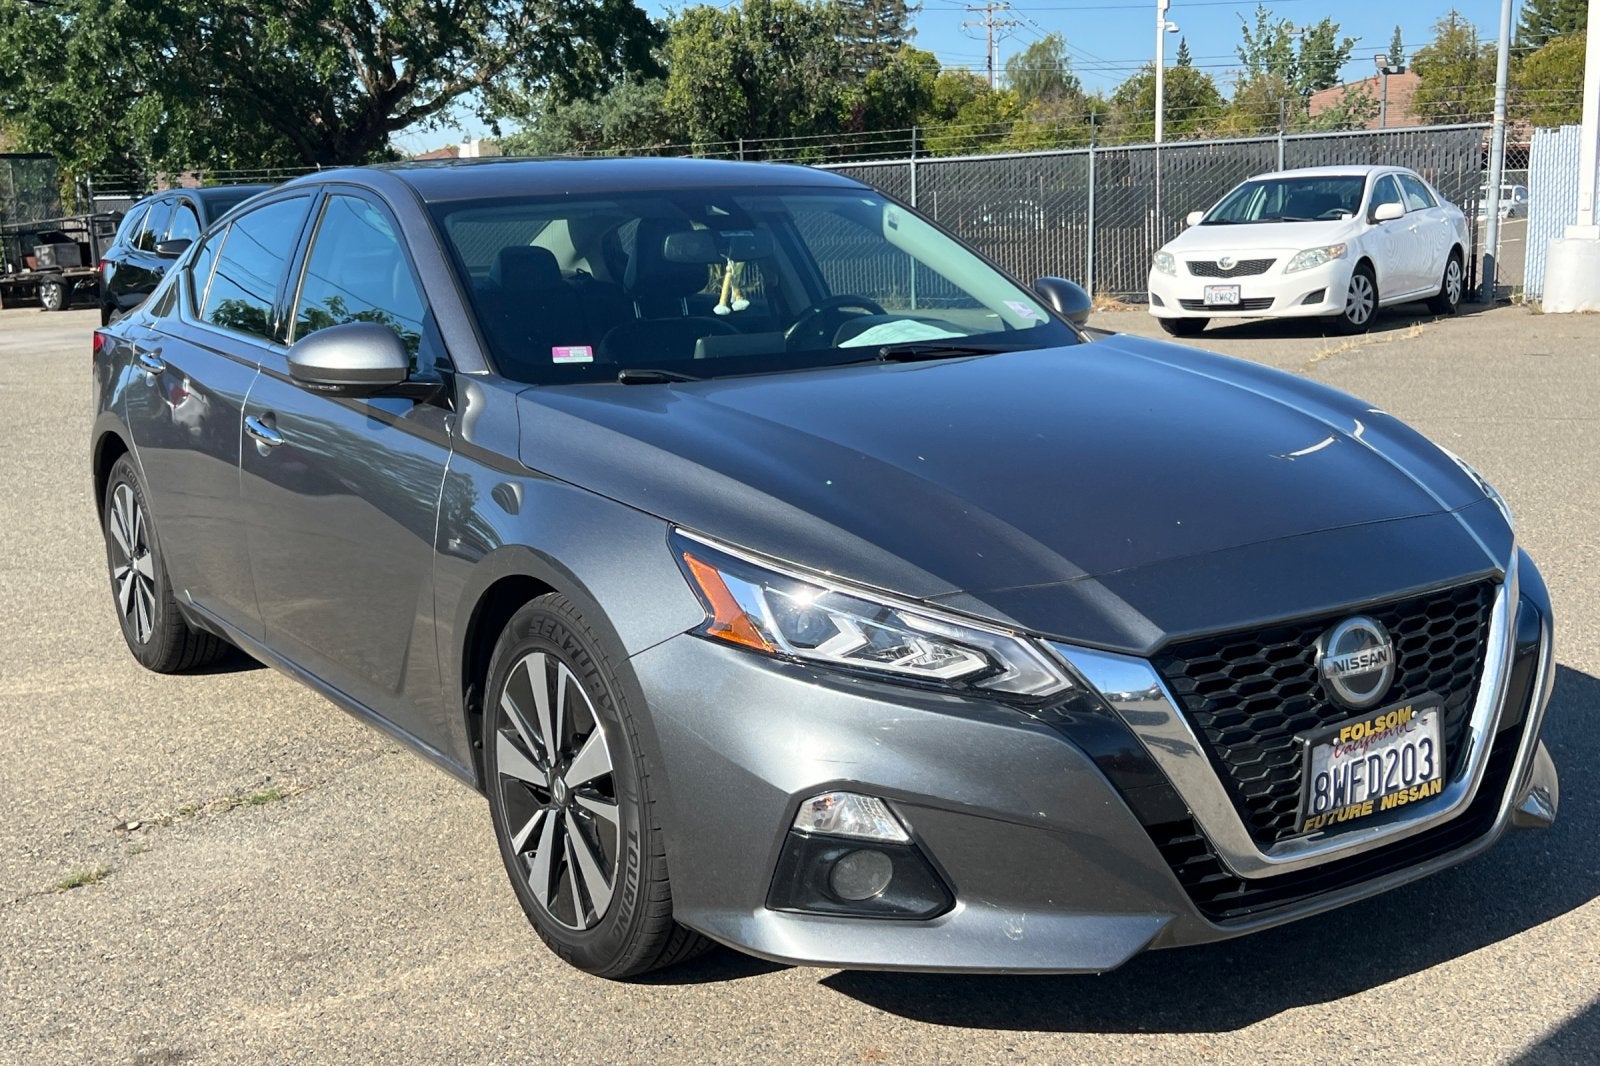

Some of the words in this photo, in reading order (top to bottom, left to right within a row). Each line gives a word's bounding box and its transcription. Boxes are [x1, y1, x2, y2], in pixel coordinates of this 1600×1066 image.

[1333, 650, 1387, 672] NISSAN
[1340, 705, 1412, 743] FOLSOM
[1314, 737, 1433, 814] 8WFD203
[1303, 800, 1374, 832] FUTURE
[1380, 778, 1442, 811] NISSAN
[611, 829, 639, 938] TOURING
